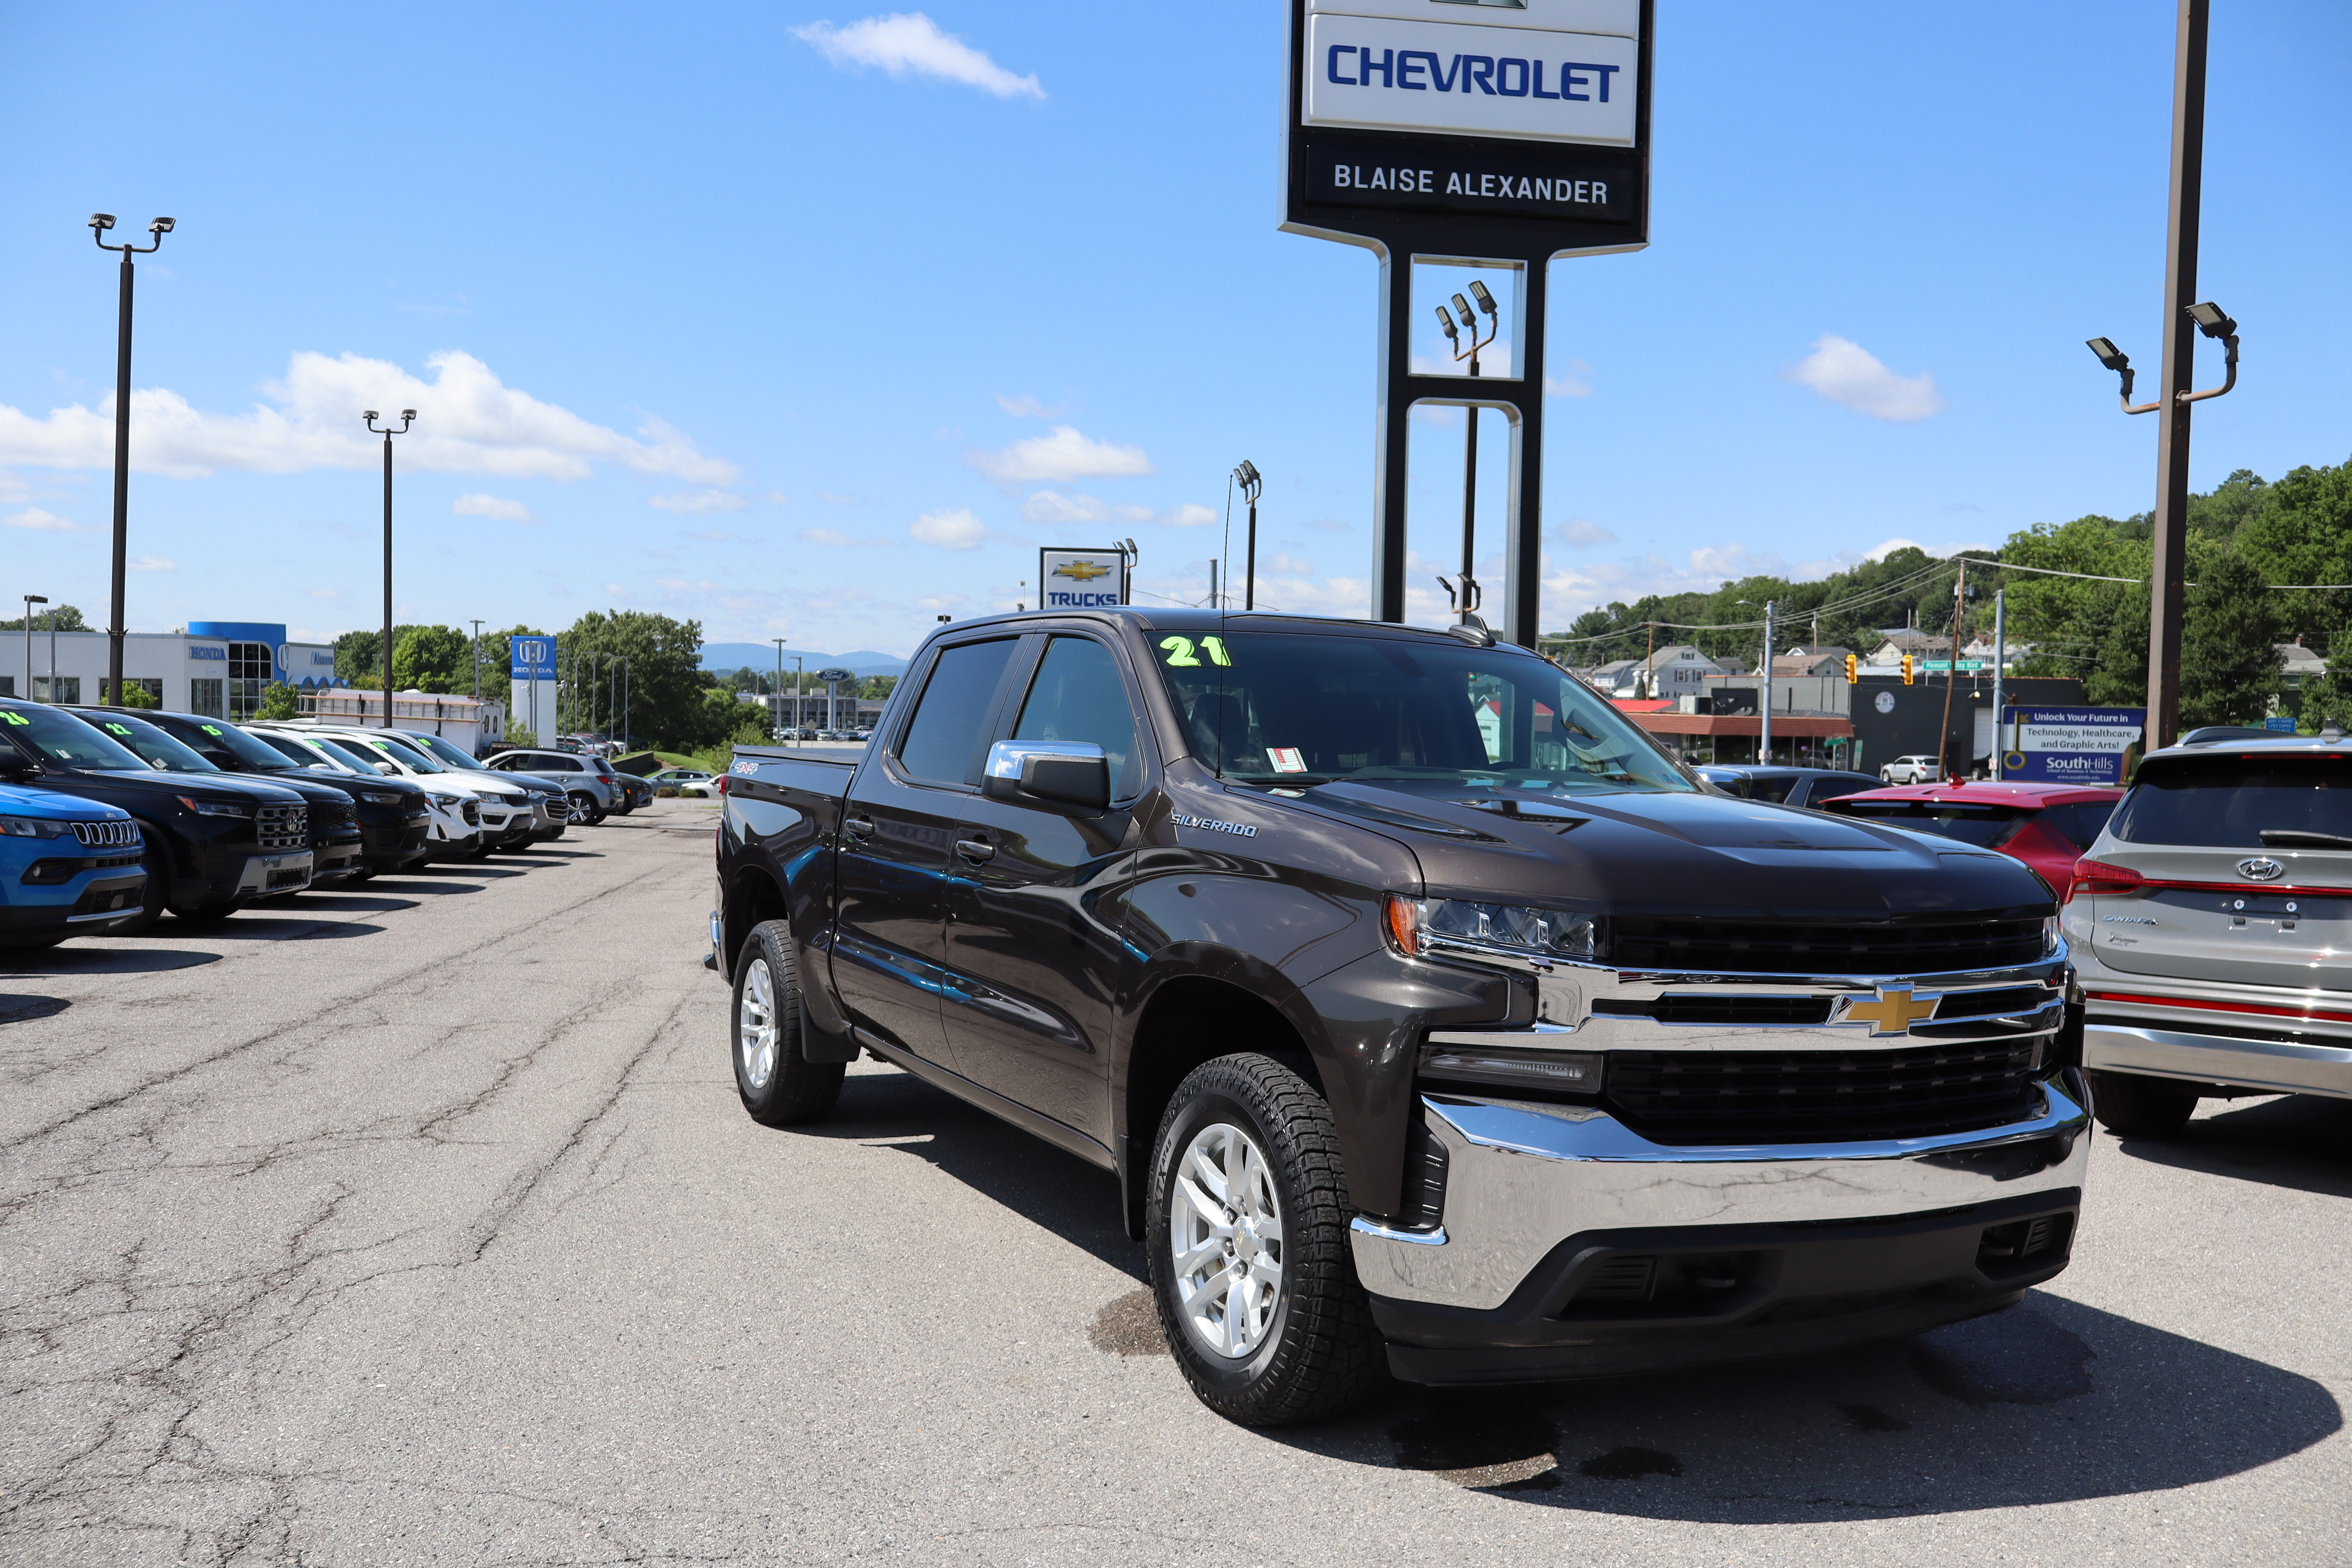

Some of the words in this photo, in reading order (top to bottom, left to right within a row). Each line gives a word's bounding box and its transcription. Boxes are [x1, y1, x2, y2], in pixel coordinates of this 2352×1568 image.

[1328, 44, 1619, 102] CHEVROLET
[1334, 165, 1434, 192] BLAISE
[1446, 172, 1607, 204] ALEXANDER
[1049, 592, 1117, 606] TRUCKS
[189, 646, 227, 660] HONDA
[1160, 636, 1232, 666] 21
[823, 671, 843, 679] Ford
[2034, 713, 2065, 722] Unlock
[105, 723, 133, 735] 22
[2027, 728, 2080, 738] Technology,
[2082, 729, 2135, 739] Healthcare,
[2060, 741, 2095, 750] Graphic
[1170, 814, 1261, 838] SILVERADO
[2103, 915, 2136, 923] SANTA
